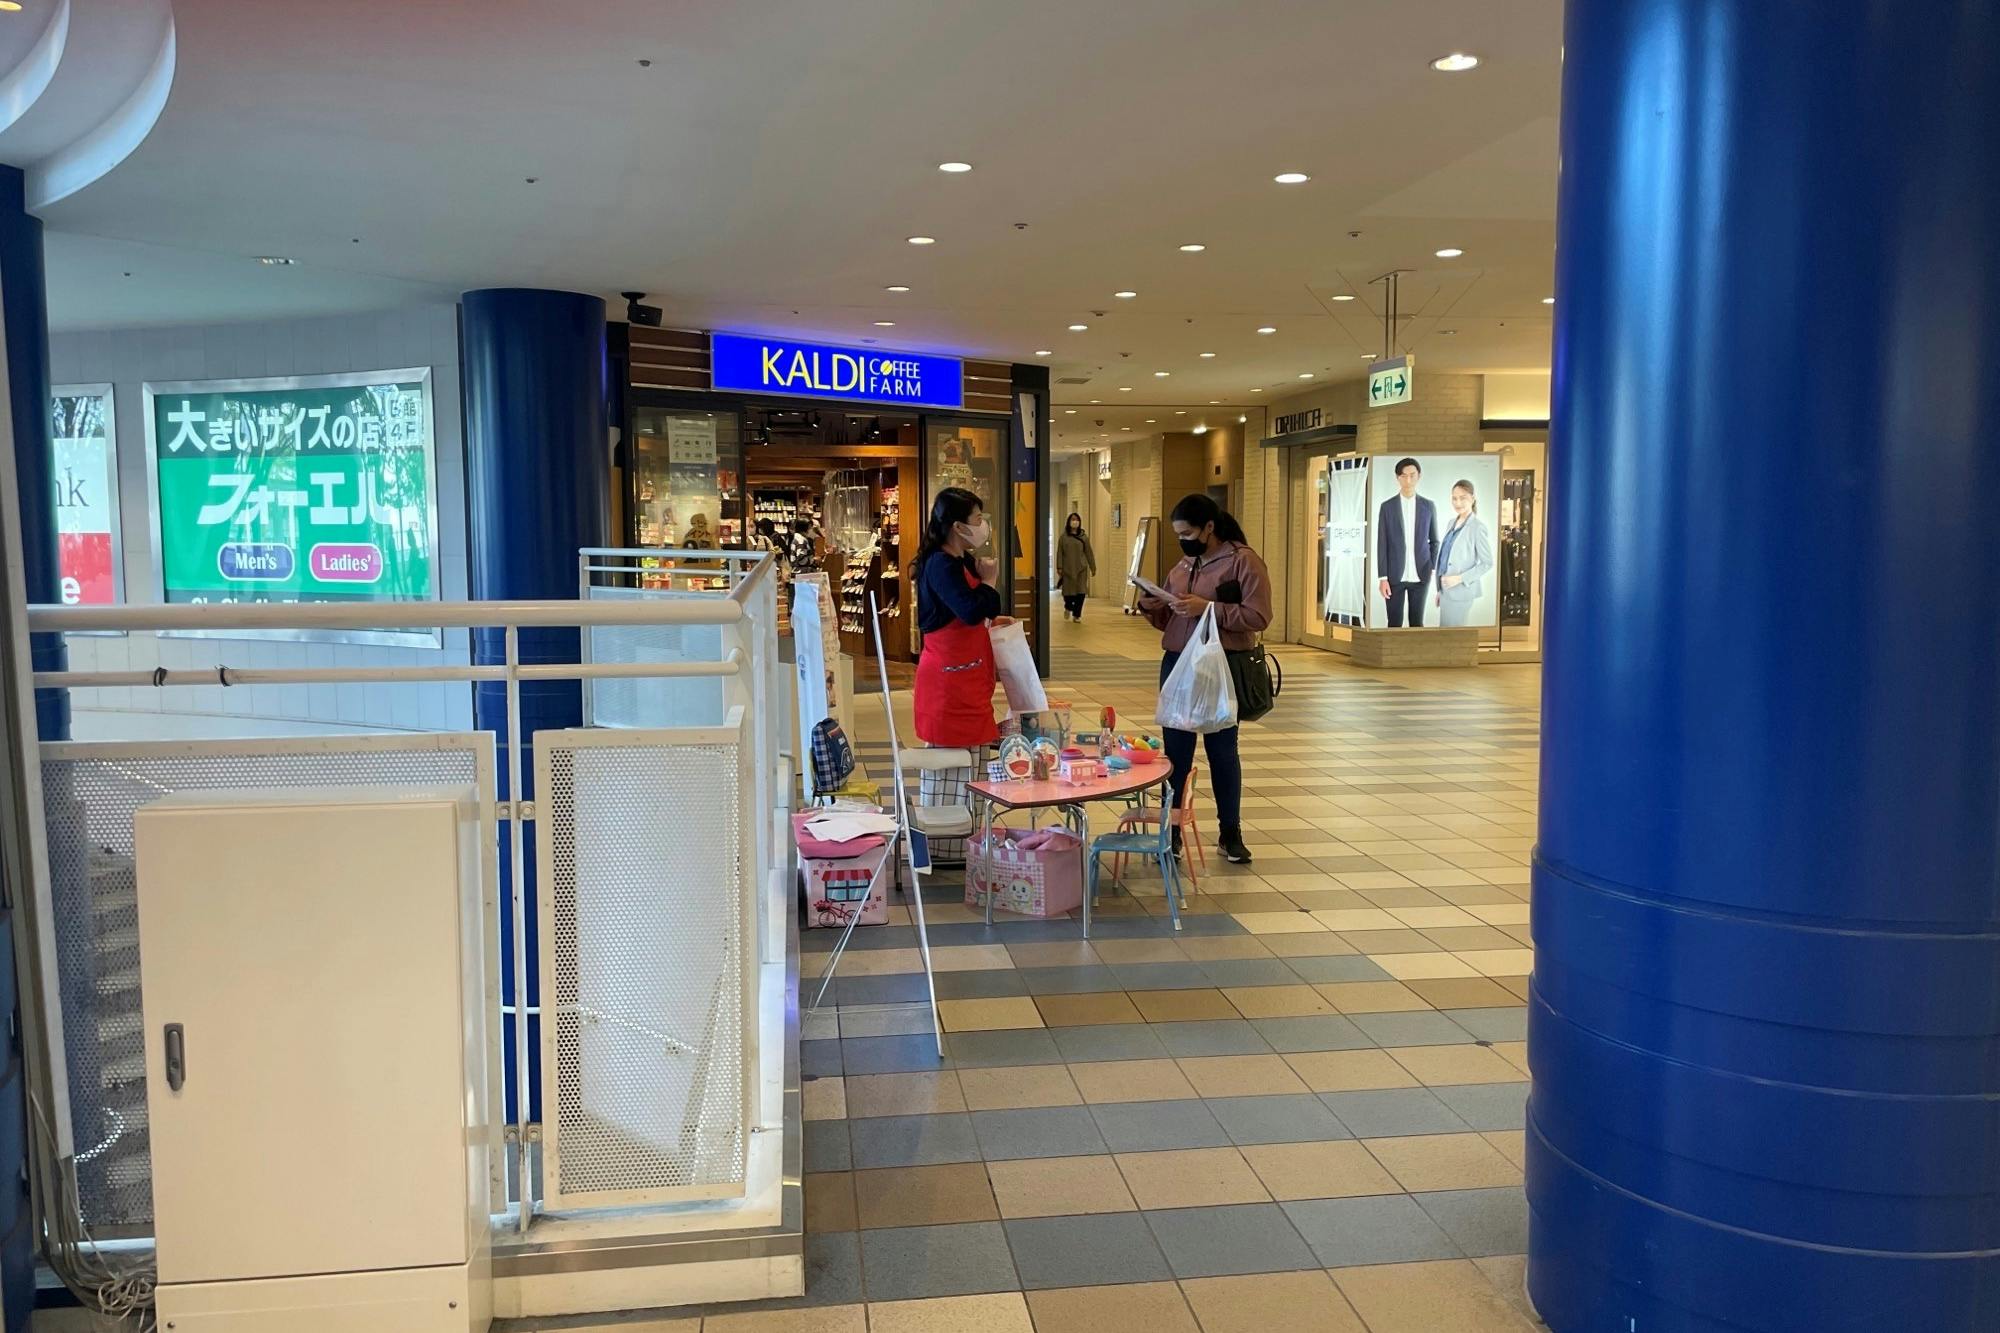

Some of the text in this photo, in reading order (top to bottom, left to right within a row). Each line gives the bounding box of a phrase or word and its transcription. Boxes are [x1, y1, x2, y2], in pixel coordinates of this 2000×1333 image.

[762, 346, 865, 392] KALDI
[869, 358, 921, 379] COFFEE
[870, 377, 922, 397] FARM
[1275, 408, 1321, 435] ORIHICA
[196, 471, 395, 525] フォーエル
[235, 553, 277, 570] Men's
[321, 554, 371, 572] Ladies'
